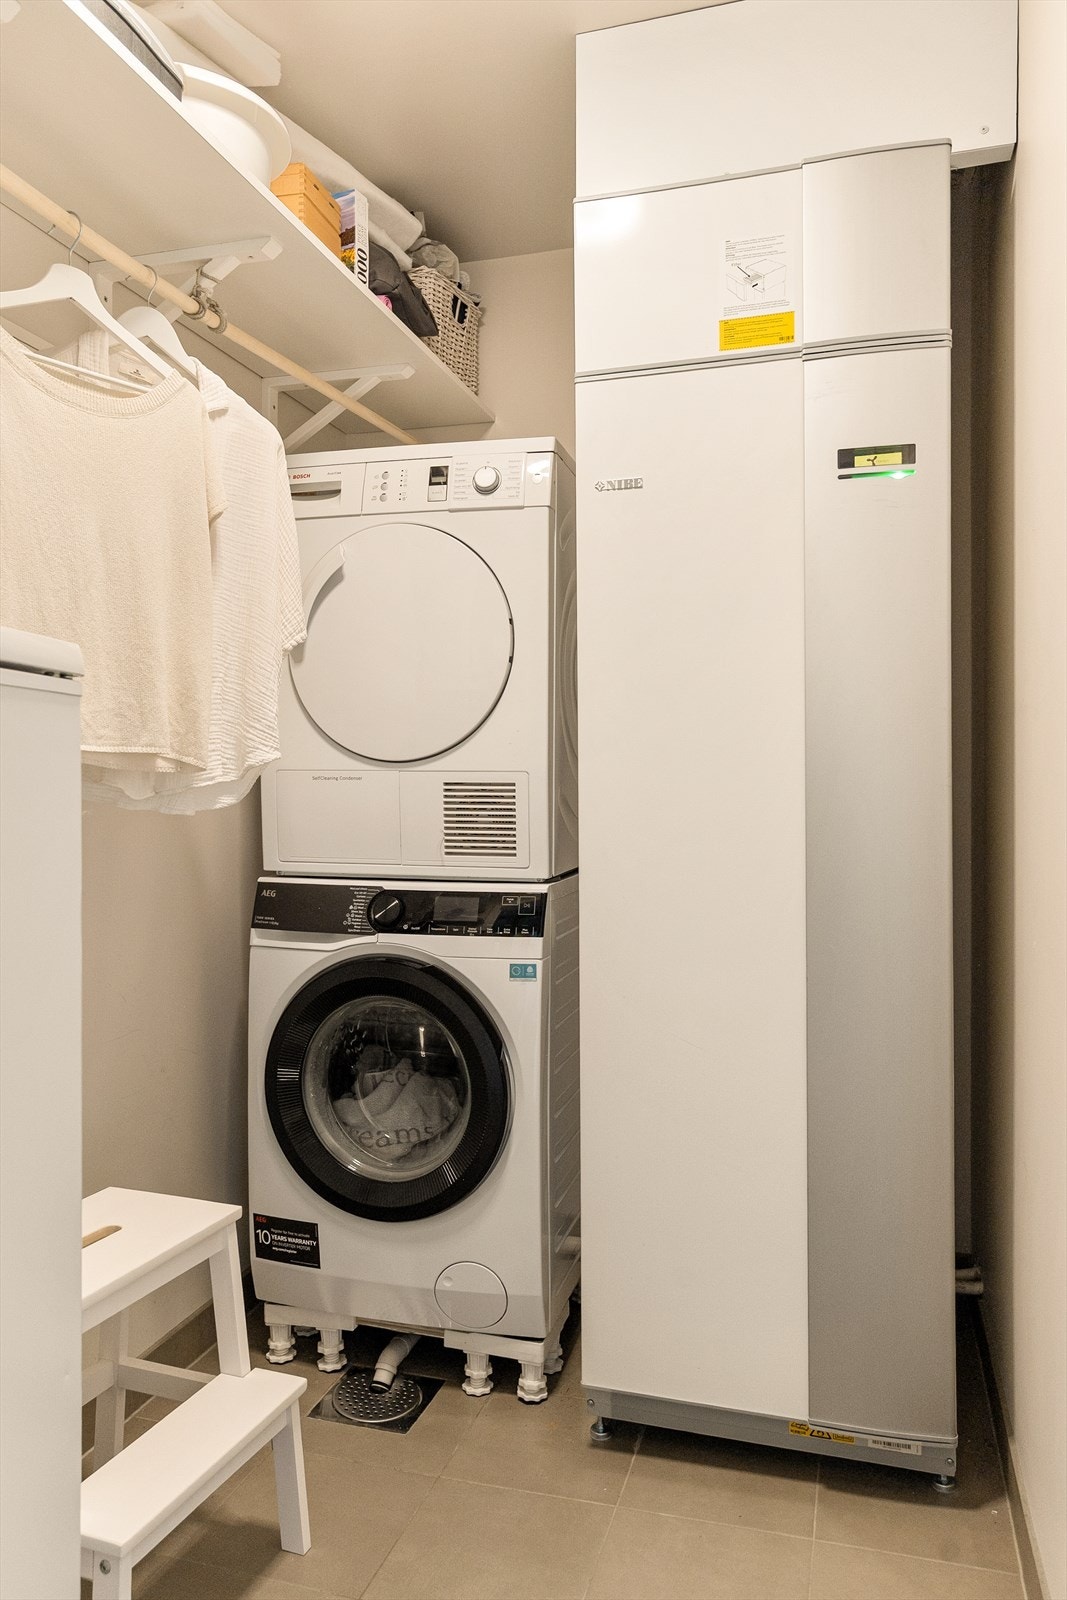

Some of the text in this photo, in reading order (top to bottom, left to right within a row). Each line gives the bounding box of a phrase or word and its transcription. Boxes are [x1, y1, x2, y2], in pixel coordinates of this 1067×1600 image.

[606, 477, 644, 491] NIBE
[261, 889, 277, 898] AEG
[256, 1229, 271, 1245] 10
[271, 1234, 317, 1246] YEARS WARRANTY
